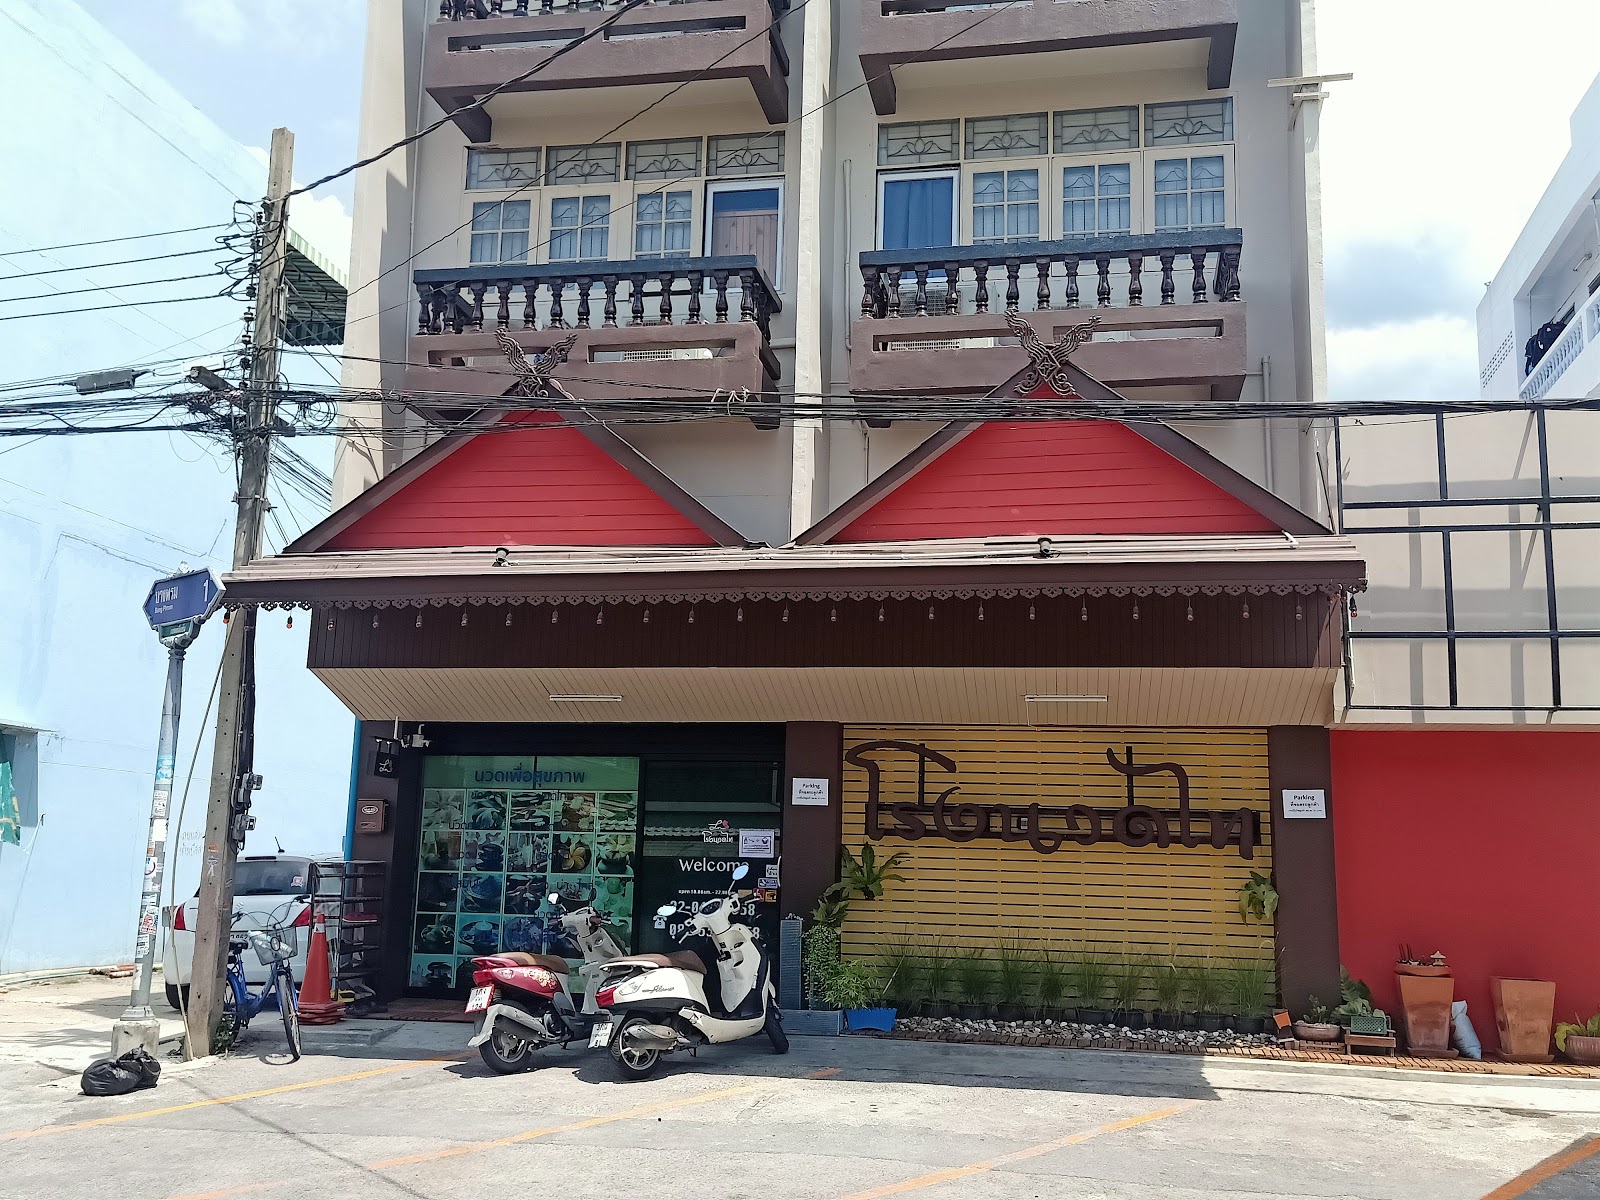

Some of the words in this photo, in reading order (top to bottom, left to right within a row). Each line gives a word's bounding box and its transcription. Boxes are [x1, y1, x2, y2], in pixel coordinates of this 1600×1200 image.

[203, 579, 208, 602] 1
[474, 762, 585, 788] นวดเพื่อสุขภาพ
